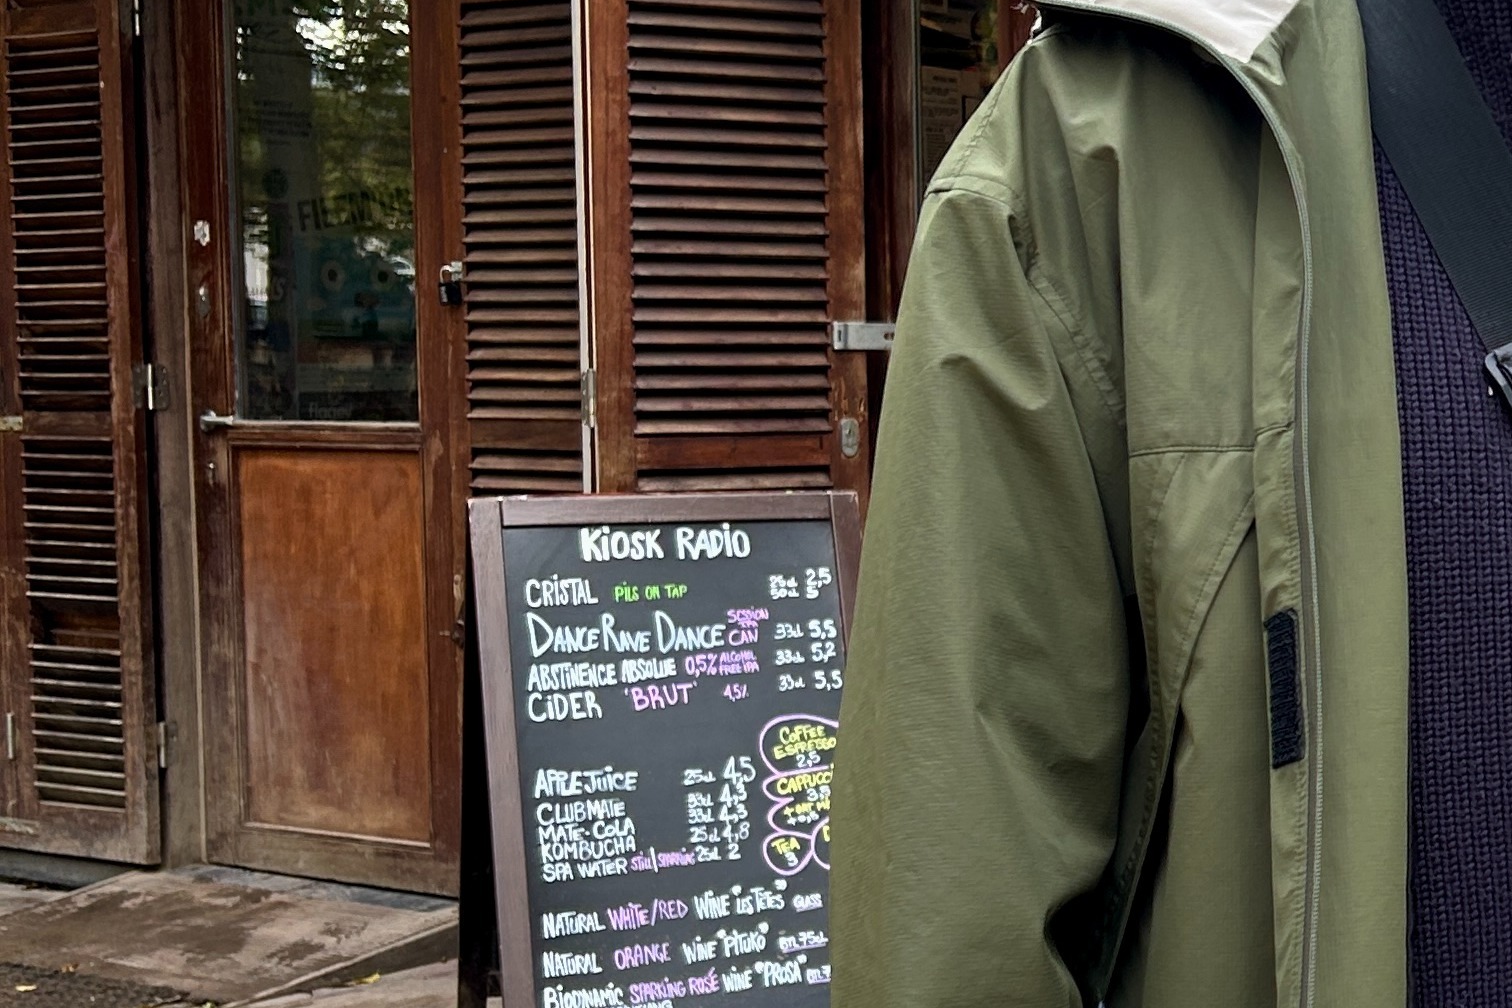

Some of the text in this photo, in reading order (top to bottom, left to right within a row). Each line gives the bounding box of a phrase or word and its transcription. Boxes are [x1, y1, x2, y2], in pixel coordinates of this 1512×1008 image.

[645, 586, 660, 600] ON
[664, 583, 688, 599] TAP
[806, 567, 831, 588] 2,5
[806, 586, 819, 599] 5
[526, 612, 600, 657] DANCE
[654, 610, 727, 654] DANCE
[729, 628, 758, 646] CAN
[808, 619, 837, 639] 5,5
[685, 653, 718, 678] 0,5%
[811, 642, 836, 663] 5,2
[814, 669, 842, 691] 5,5
[773, 737, 837, 760] ESPRESSO
[796, 750, 821, 768] 2,5
[723, 755, 756, 785] 4,5
[719, 780, 747, 808] 4,3
[719, 804, 748, 824] 4,3
[541, 835, 636, 864] KOMBUCHA
[722, 821, 750, 843] 4,8
[771, 837, 800, 855] TEA
[542, 862, 574, 883] SPA
[577, 857, 628, 878] WATER
[727, 843, 741, 860] 2
[784, 852, 799, 867] 3
[542, 911, 606, 939] NATURAL
[542, 951, 603, 978] NATURAL
[614, 942, 671, 970] ORANGE
[688, 966, 720, 995] ROSÉ
